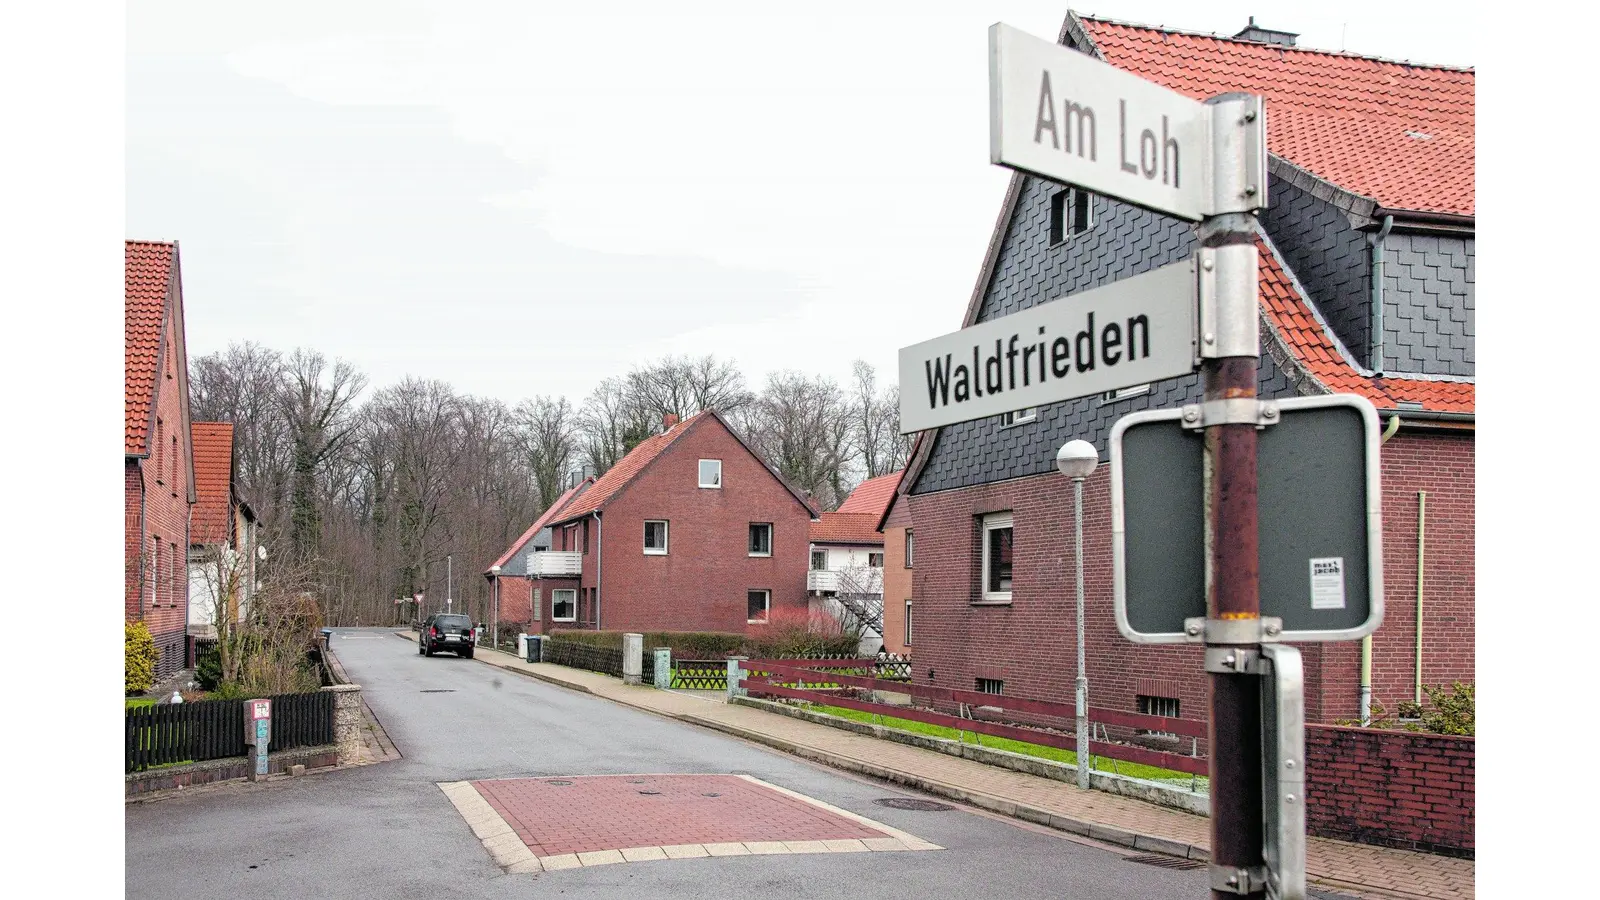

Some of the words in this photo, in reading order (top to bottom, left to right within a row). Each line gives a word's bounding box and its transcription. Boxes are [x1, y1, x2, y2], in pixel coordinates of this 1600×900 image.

[1034, 70, 1097, 161] Am
[1119, 99, 1181, 189] Loh
[924, 311, 1150, 409] Waldfrieden
